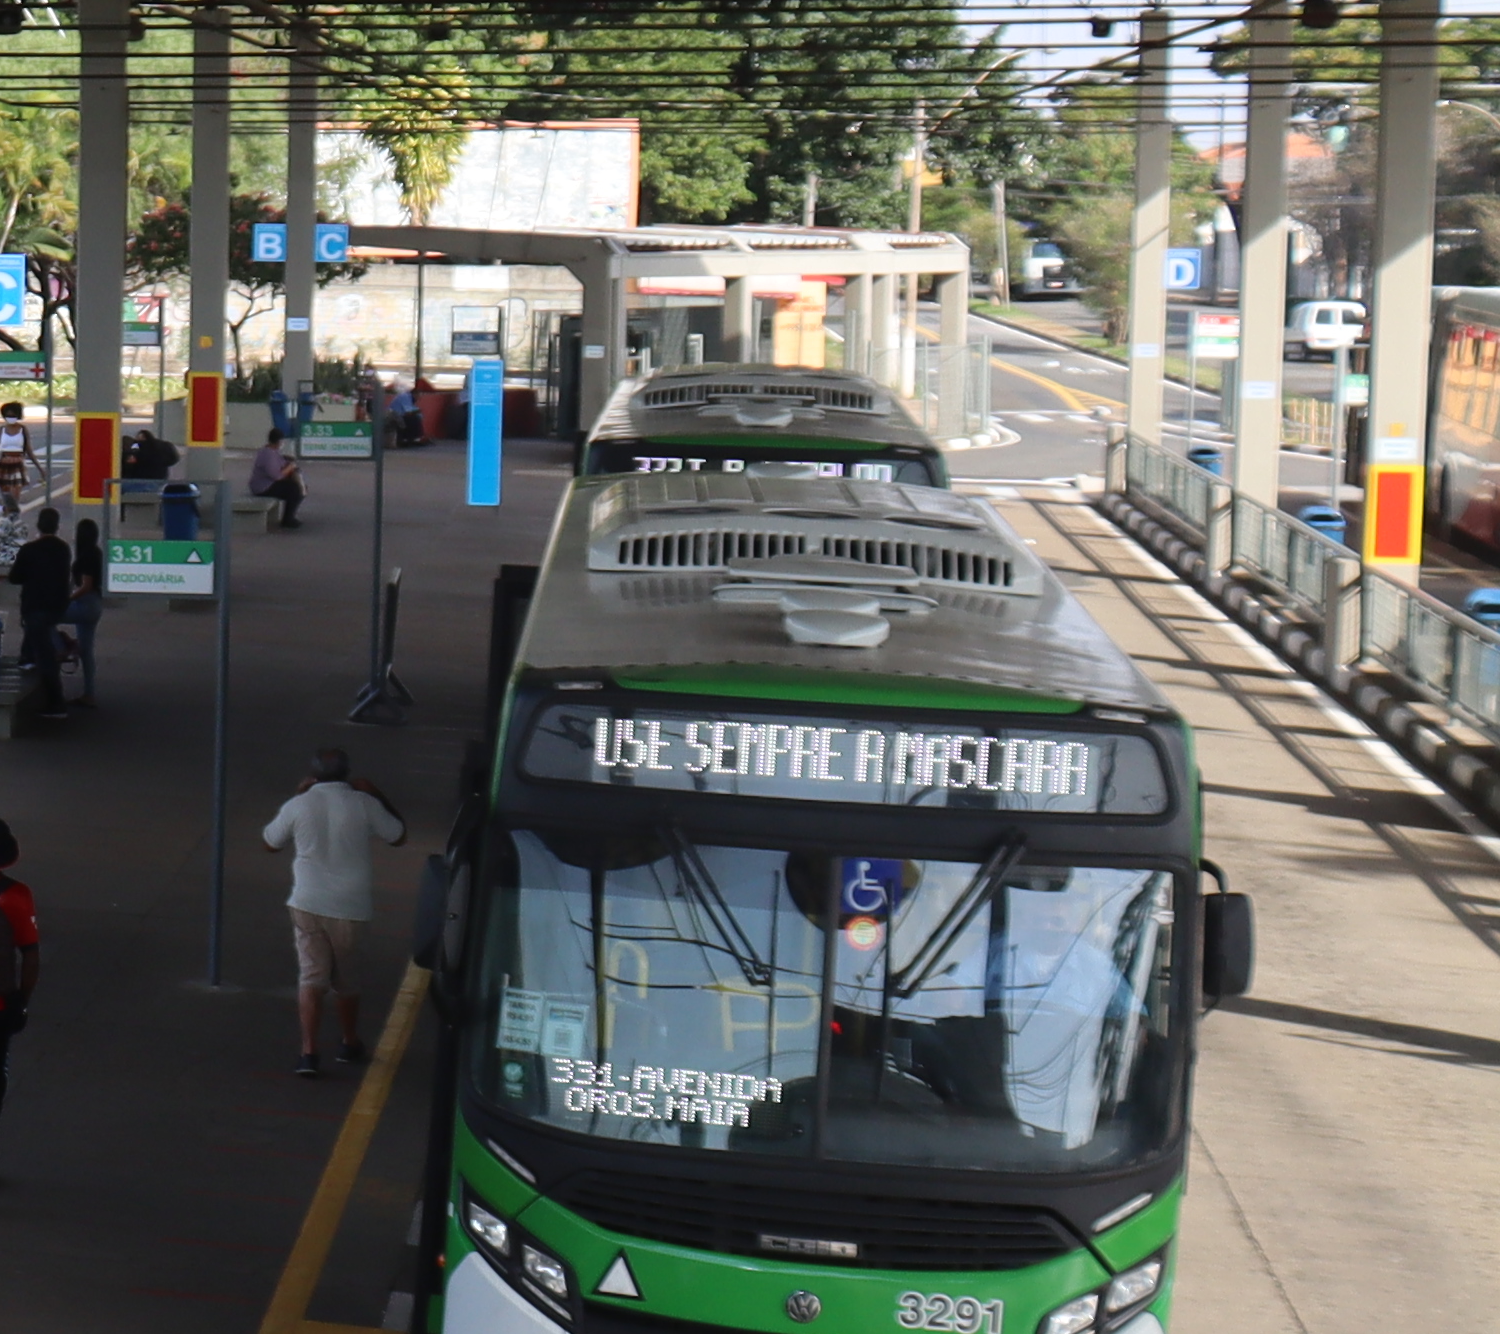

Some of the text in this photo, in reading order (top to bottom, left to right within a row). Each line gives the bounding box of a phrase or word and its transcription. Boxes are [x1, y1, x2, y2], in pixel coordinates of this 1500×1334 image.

[258, 232, 283, 260] B
[320, 232, 344, 260] C
[1169, 257, 1196, 287] D
[304, 424, 334, 437] 3.33
[112, 545, 153, 563] 3.31
[112, 571, 186, 584] RODOVIÁRIA
[594, 717, 1089, 796] USE SEMPRE A MASCARA
